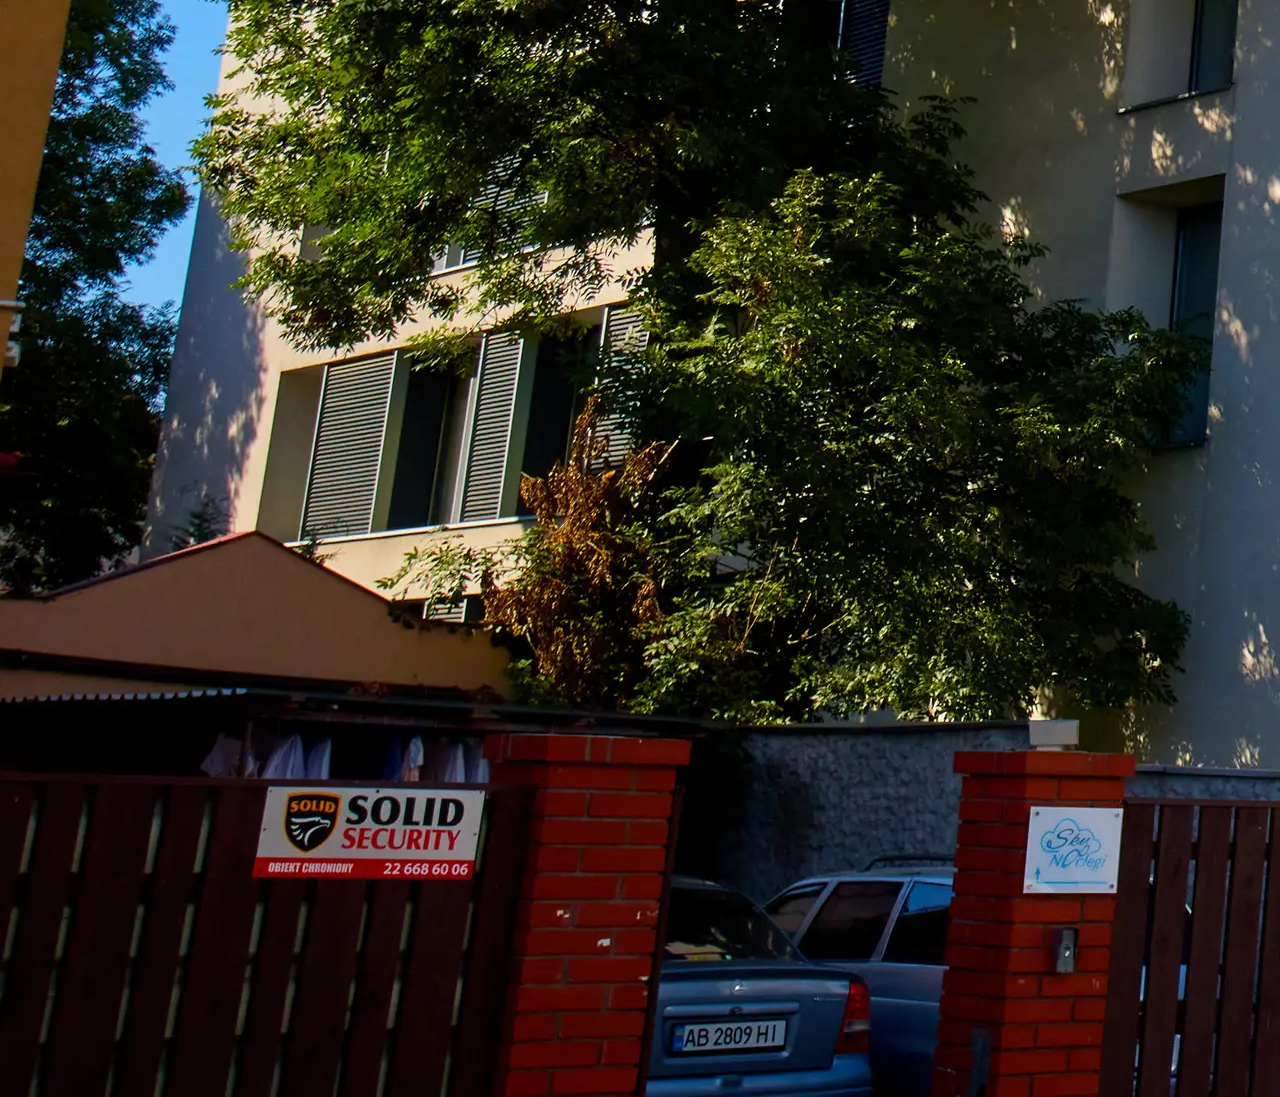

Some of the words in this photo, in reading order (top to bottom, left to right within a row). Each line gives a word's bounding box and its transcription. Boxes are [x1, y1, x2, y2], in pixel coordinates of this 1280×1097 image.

[289, 799, 336, 814] SOLID
[345, 794, 465, 827] SOLID
[341, 826, 461, 851] SECURITY
[1046, 828, 1091, 856] Sky
[268, 862, 301, 873] OBIEKT
[302, 862, 354, 874] CHRONIONY
[383, 862, 400, 875] 22
[404, 863, 429, 875] 668
[431, 863, 449, 875] 60
[451, 863, 469, 876] 06
[683, 1028, 710, 1048] AB
[713, 1025, 753, 1046] 2809
[756, 1024, 777, 1044] HI
